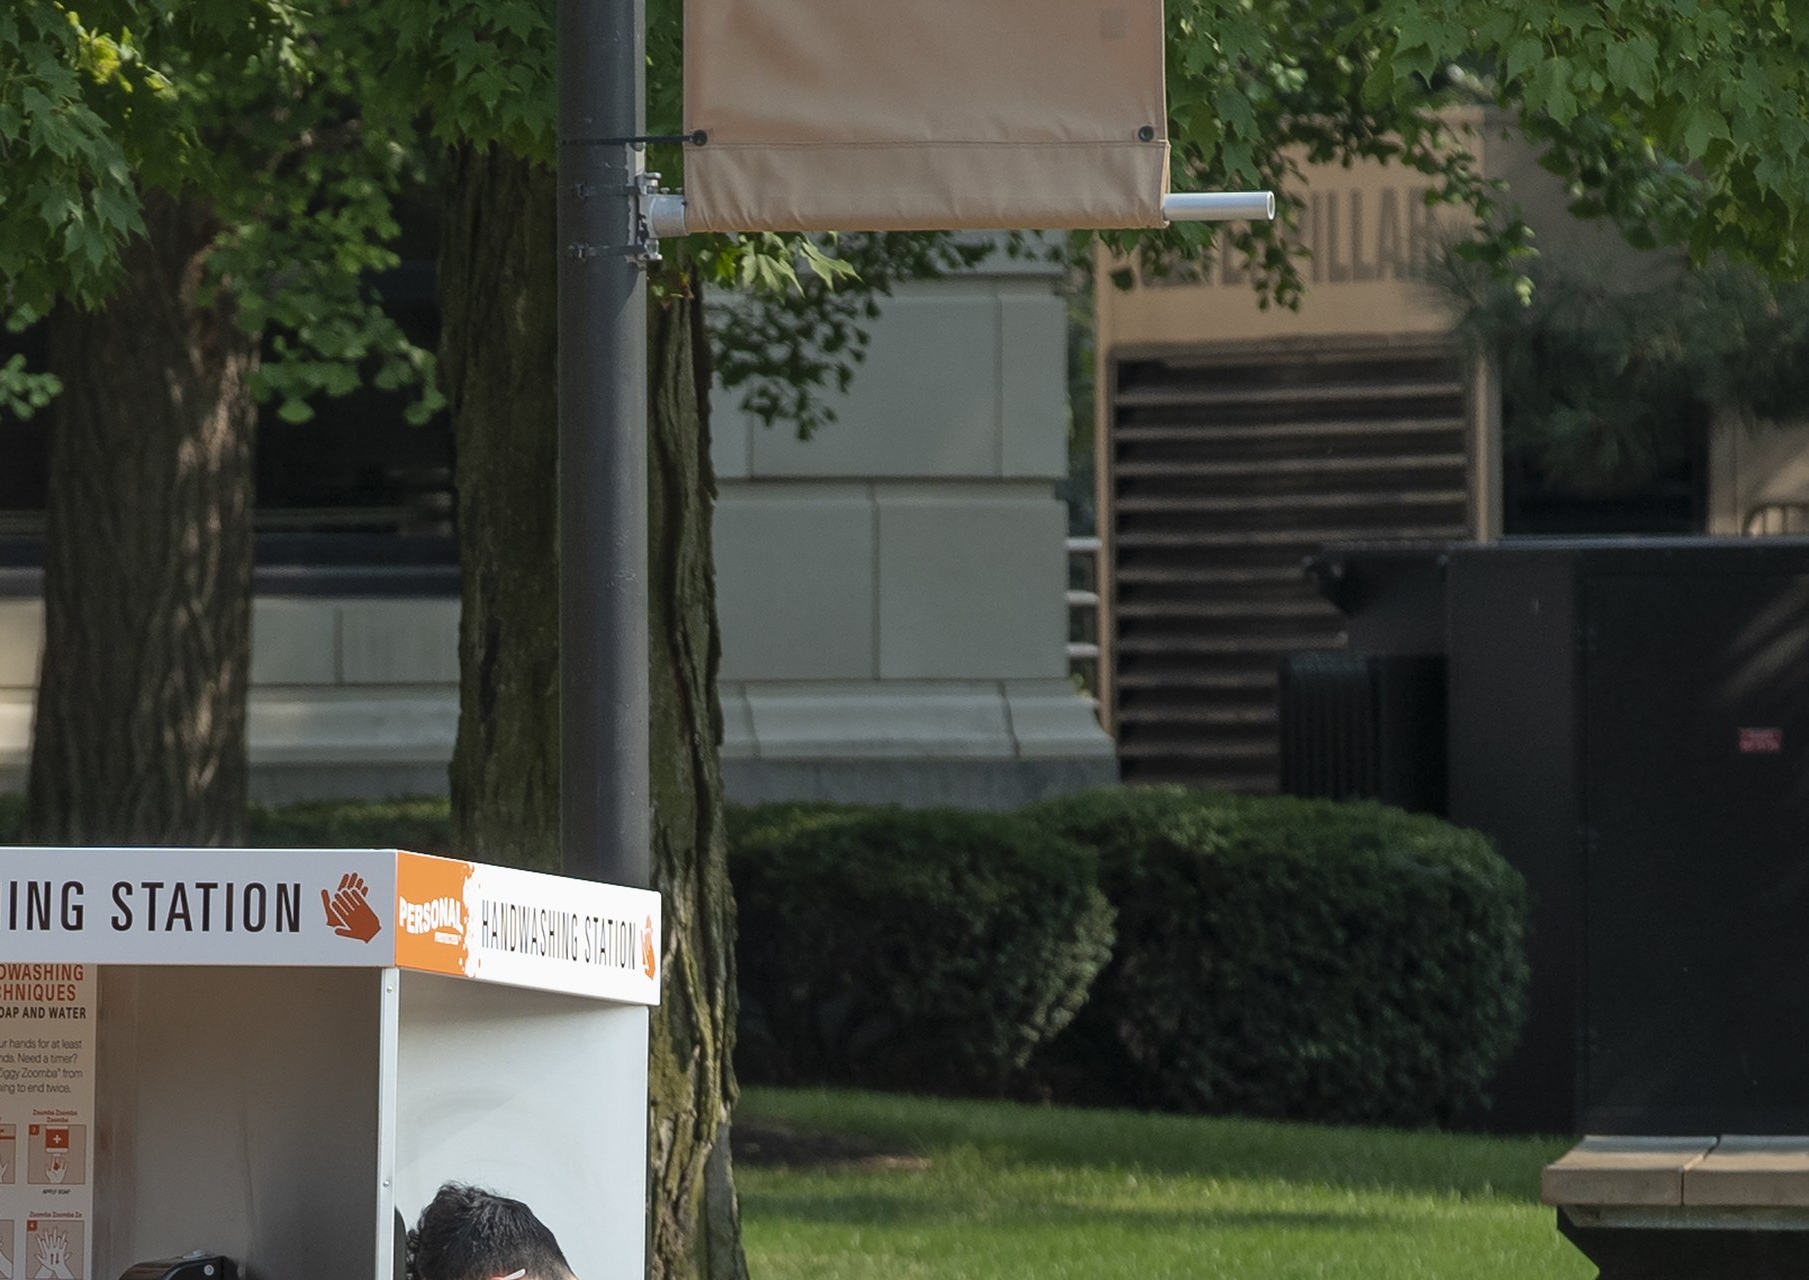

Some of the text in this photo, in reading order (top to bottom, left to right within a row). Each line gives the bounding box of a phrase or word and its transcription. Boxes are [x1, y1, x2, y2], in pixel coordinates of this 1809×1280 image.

[110, 881, 301, 933] STATION
[399, 896, 463, 934] PERSONAL
[482, 899, 636, 970] HANDWASHING STATION
[22, 1007, 46, 1018] AND
[49, 1007, 86, 1019] WATER
[9, 1038, 36, 1049] hands
[38, 1038, 50, 1049] for
[51, 1040, 60, 1049] at
[61, 1039, 82, 1049] least
[18, 1053, 40, 1064] Need
[43, 1056, 48, 1064] a
[50, 1053, 78, 1064] timer?
[62, 1068, 83, 1078] from
[17, 1084, 25, 1093] to
[27, 1084, 45, 1093] end
